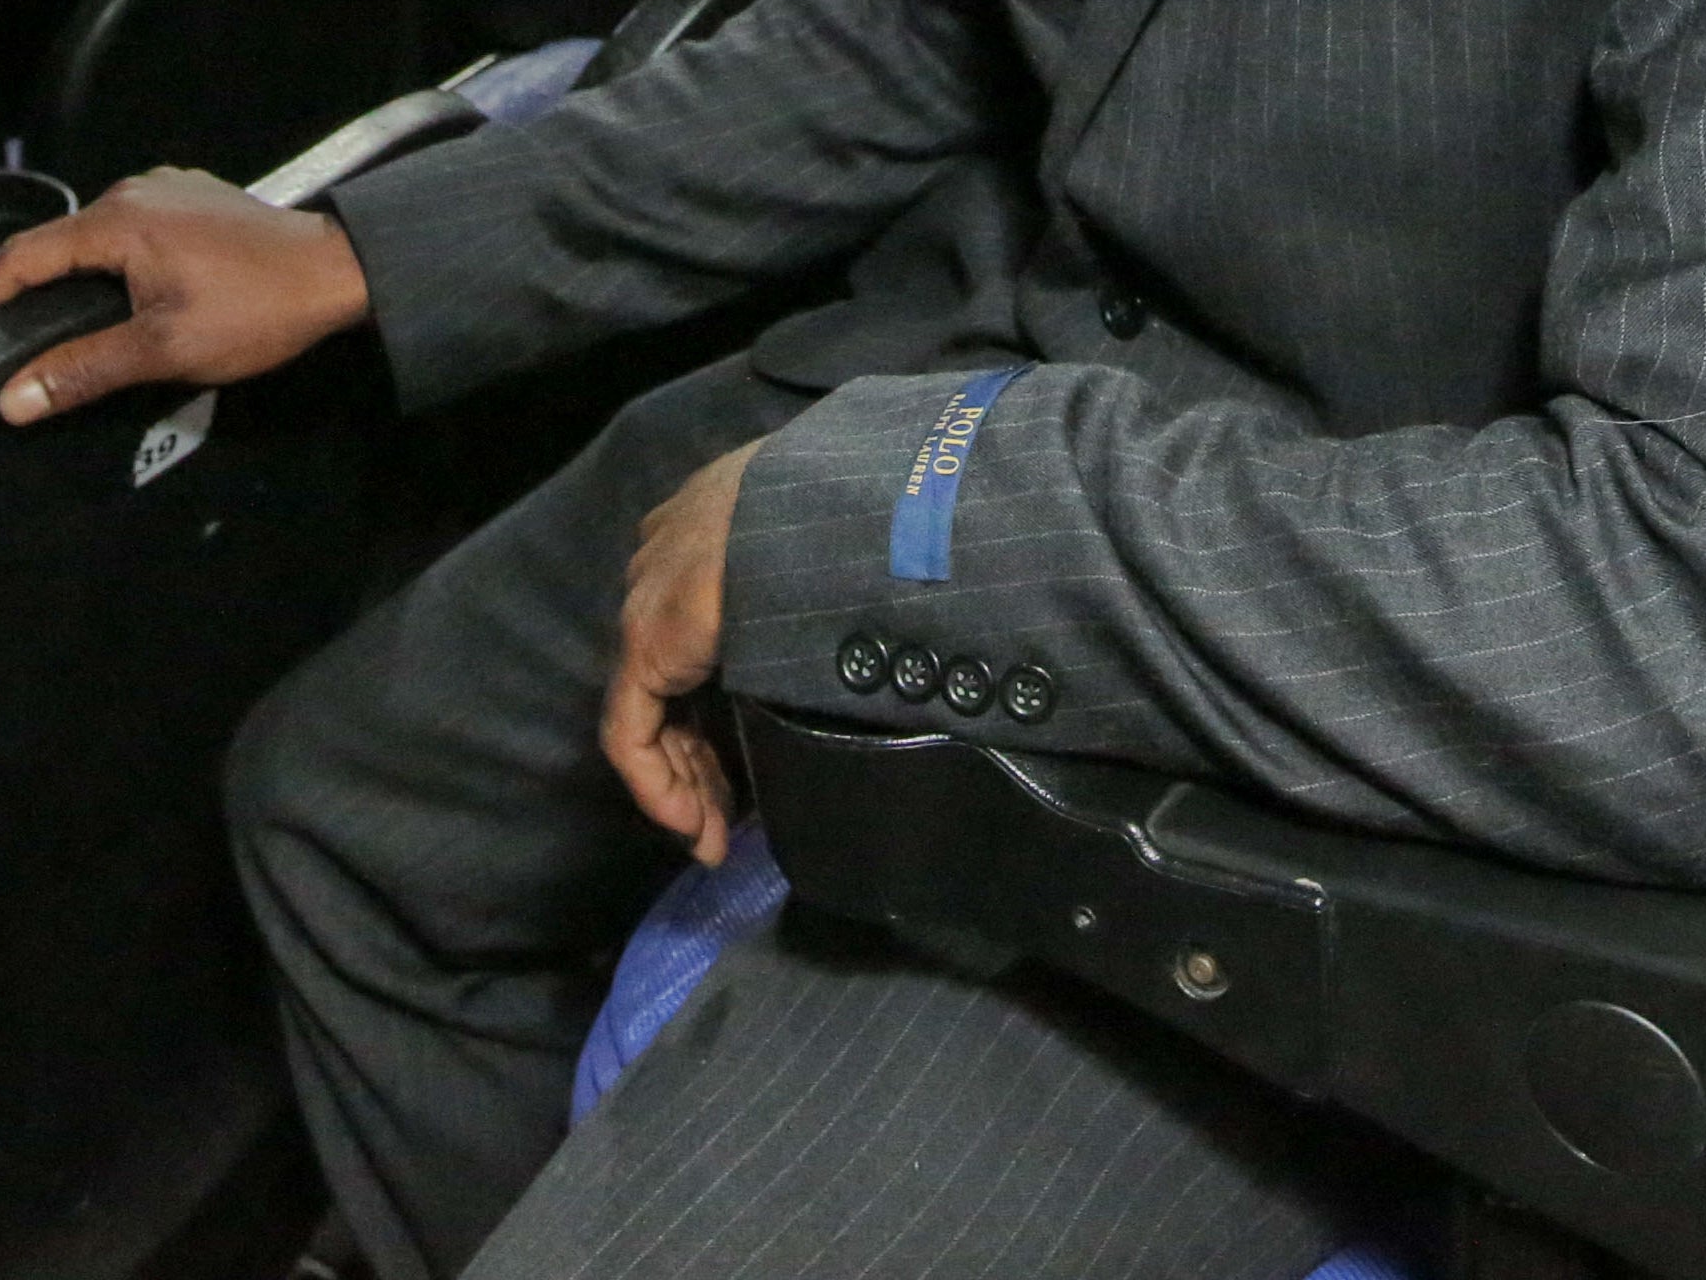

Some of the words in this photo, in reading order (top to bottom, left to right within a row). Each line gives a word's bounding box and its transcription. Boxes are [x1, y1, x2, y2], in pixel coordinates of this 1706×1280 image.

[933, 393, 967, 430] RALPH
[933, 407, 984, 475] POLO
[906, 436, 938, 495] LAUREN
